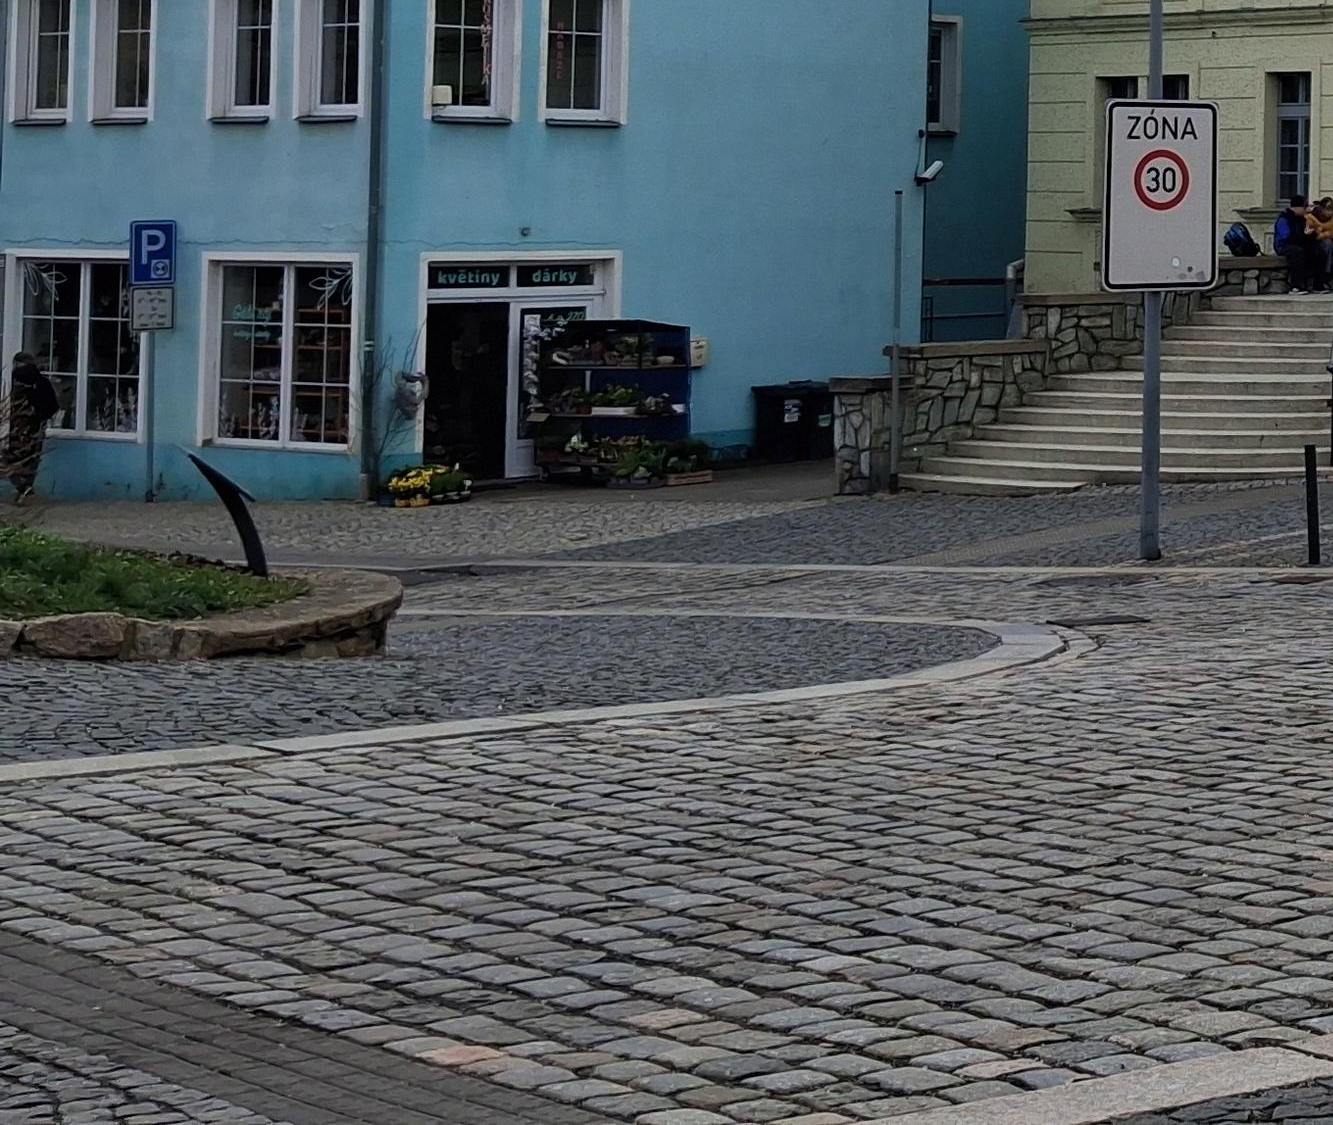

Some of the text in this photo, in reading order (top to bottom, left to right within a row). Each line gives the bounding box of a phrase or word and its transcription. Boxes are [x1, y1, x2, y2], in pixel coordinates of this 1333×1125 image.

[1127, 109, 1198, 140] ZÓNA
[1146, 167, 1177, 193] 30
[141, 229, 166, 265] P
[437, 268, 577, 285] květiny dárky
